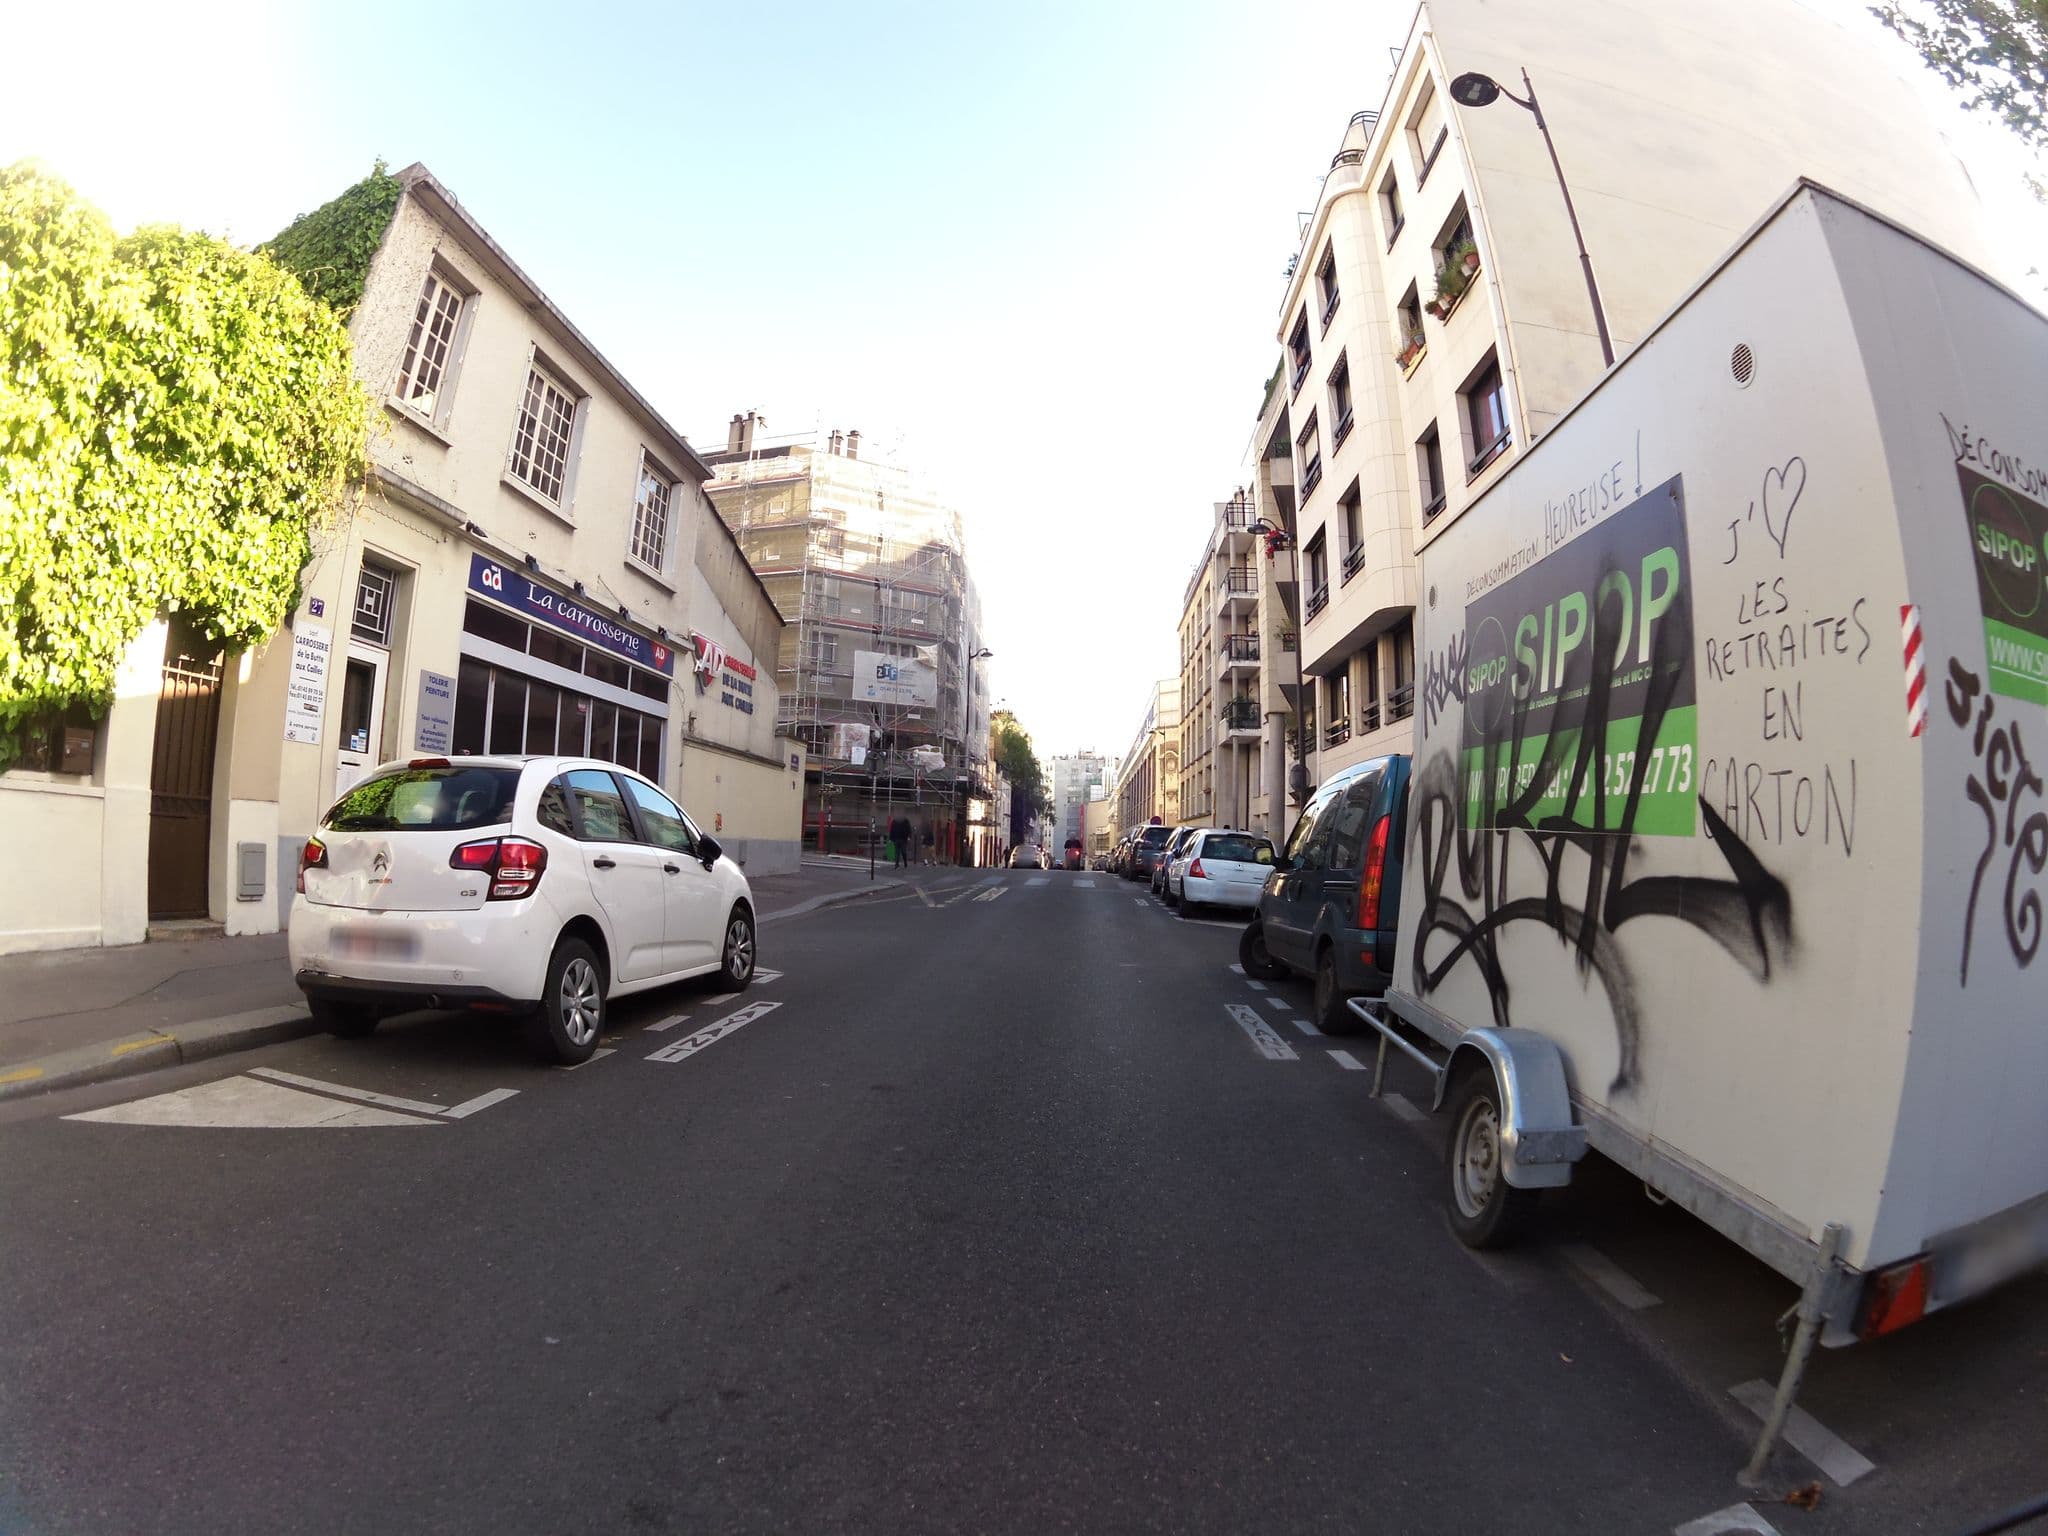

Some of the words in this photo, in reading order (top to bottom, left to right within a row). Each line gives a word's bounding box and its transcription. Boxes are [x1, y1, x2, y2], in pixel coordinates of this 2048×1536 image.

[1543, 461, 1624, 555] HEUREUSE
[1978, 524, 2036, 572] SIPOP
[311, 600, 323, 615] 27
[526, 582, 553, 610] La
[557, 599, 640, 650] carrosserie
[655, 647, 665, 660] AD
[1739, 577, 1788, 625] LES
[295, 635, 329, 652] CARROSSERIE
[1468, 655, 1507, 694] SIPOP
[1763, 680, 1803, 742] EN
[1666, 744, 1692, 793] 73
[1700, 758, 1856, 859] CARTON
